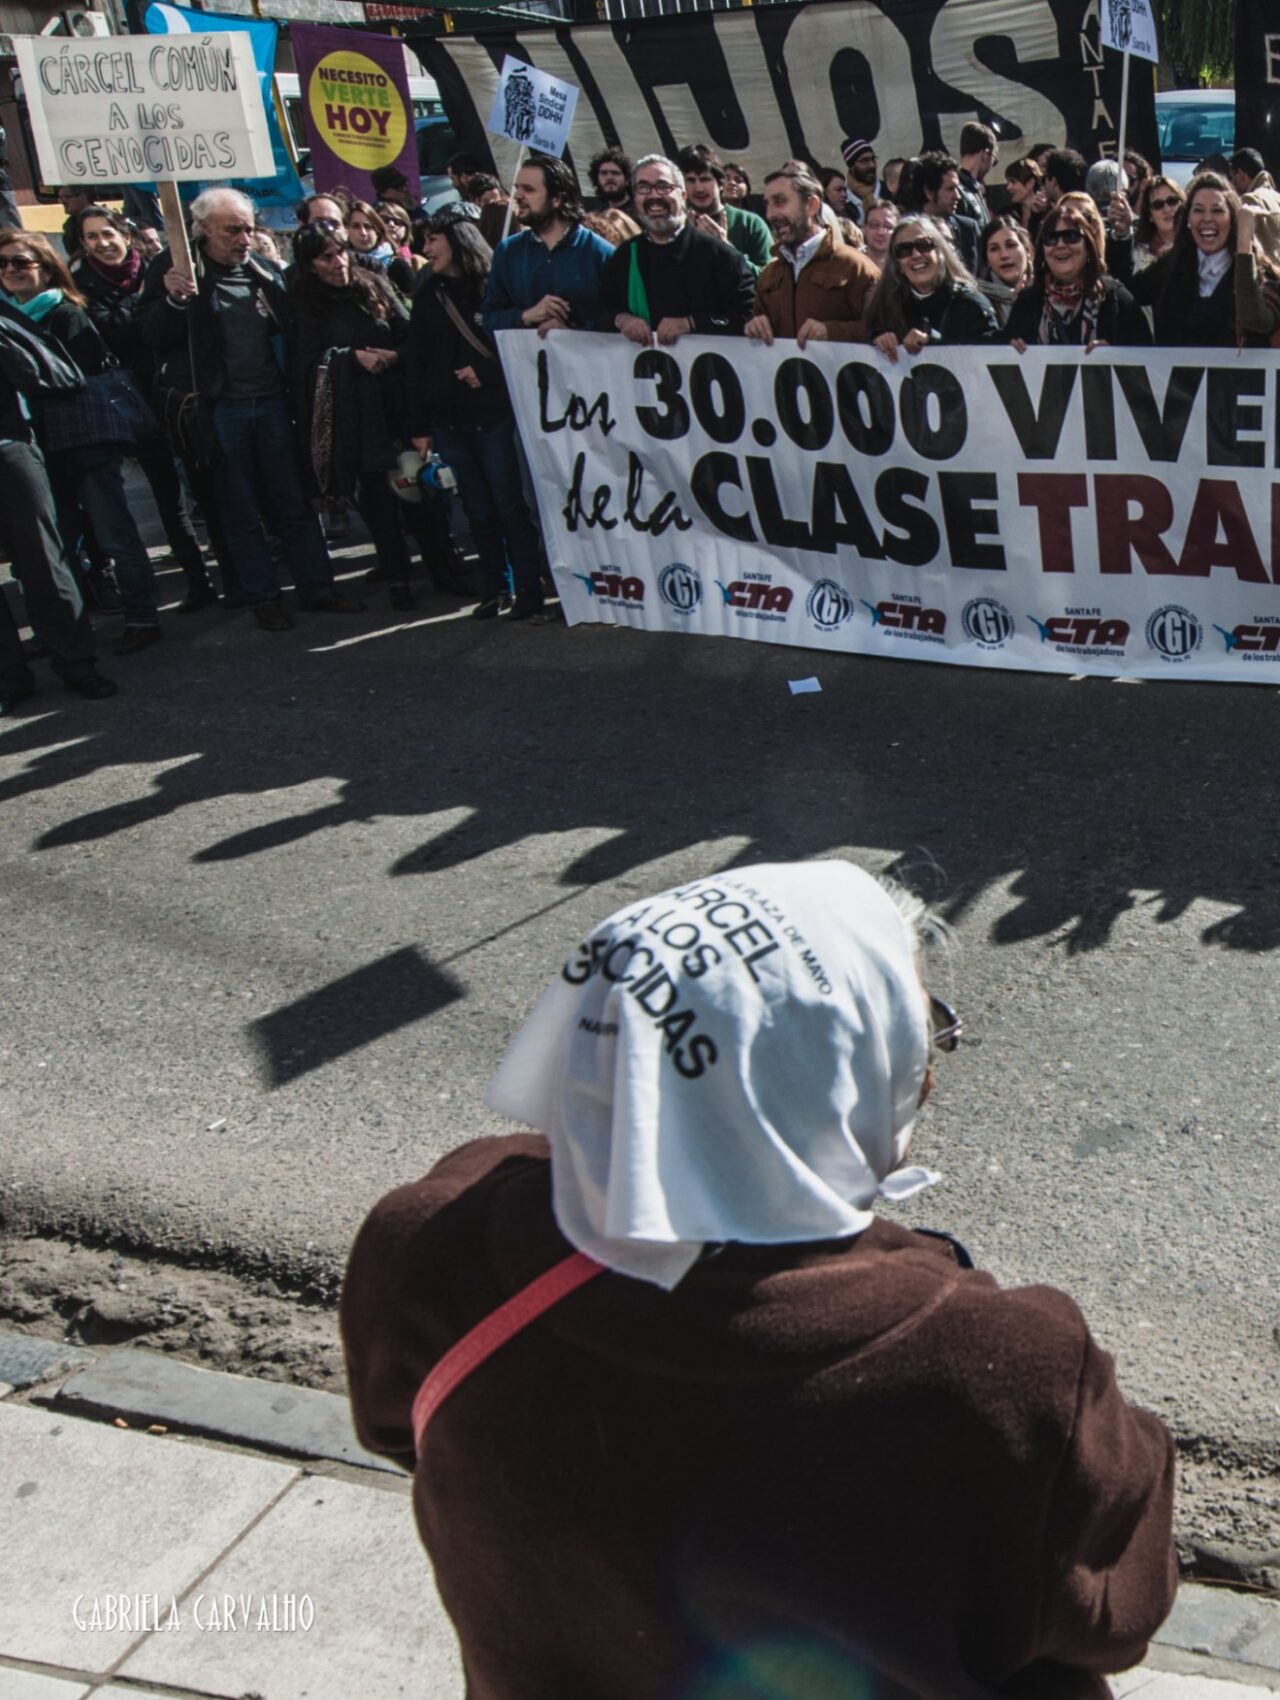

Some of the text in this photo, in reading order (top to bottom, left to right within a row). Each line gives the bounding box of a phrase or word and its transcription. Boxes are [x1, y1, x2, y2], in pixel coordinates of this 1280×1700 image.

[39, 36, 238, 95] CÁRCEL COMÚN
[318, 67, 388, 88] NECESITO
[321, 82, 391, 108] VERTE
[538, 93, 566, 112] Sindical
[550, 86, 568, 102] Mesa
[109, 102, 184, 130] A LOS
[325, 104, 392, 137] HOY
[537, 105, 564, 125] DDHH
[60, 132, 237, 176] GENOCIDAS
[537, 349, 616, 436] Los
[634, 350, 968, 460] 30.000
[690, 451, 1008, 570] CLASE
[727, 581, 794, 613] CTA
[876, 602, 946, 635] CTA
[1044, 617, 1130, 646] CTA
[645, 910, 722, 980] LOS
[743, 887, 785, 924] PLAZA
[783, 926, 807, 947] DE
[800, 948, 833, 995] MAYO
